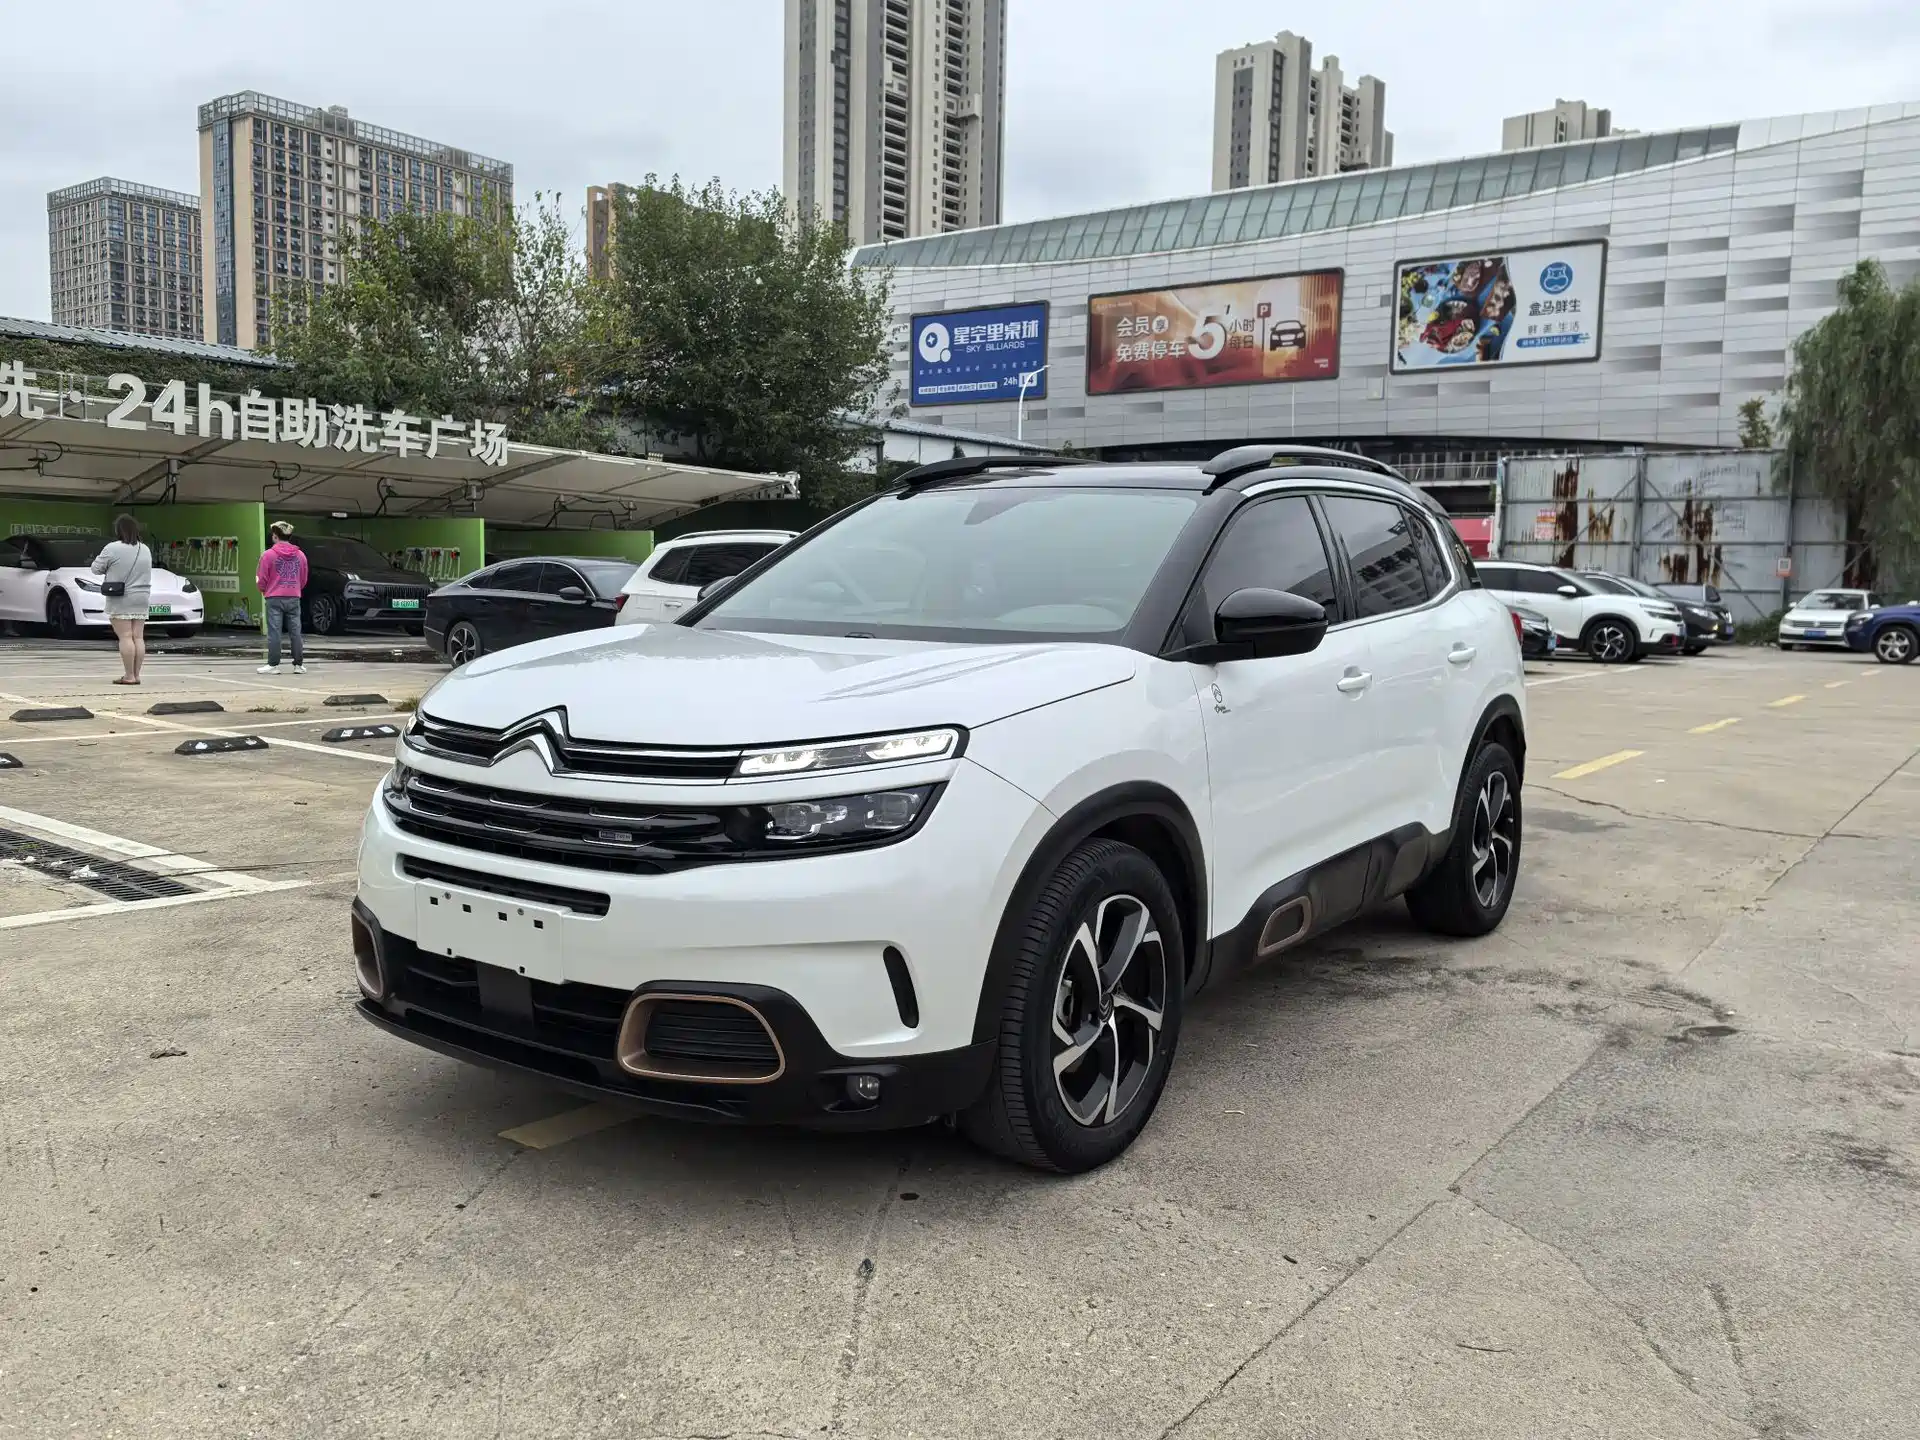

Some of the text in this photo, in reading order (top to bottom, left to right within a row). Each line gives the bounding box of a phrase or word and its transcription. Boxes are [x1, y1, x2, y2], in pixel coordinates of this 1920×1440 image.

[1529, 299, 1581, 317] 盒马鲜生
[953, 320, 1039, 345] 星空里桌球
[1229, 317, 1256, 333] 小时
[966, 340, 1026, 353] SKY BILLIARDS
[1116, 340, 1186, 363] 免费停车
[1003, 376, 1018, 386] 24h
